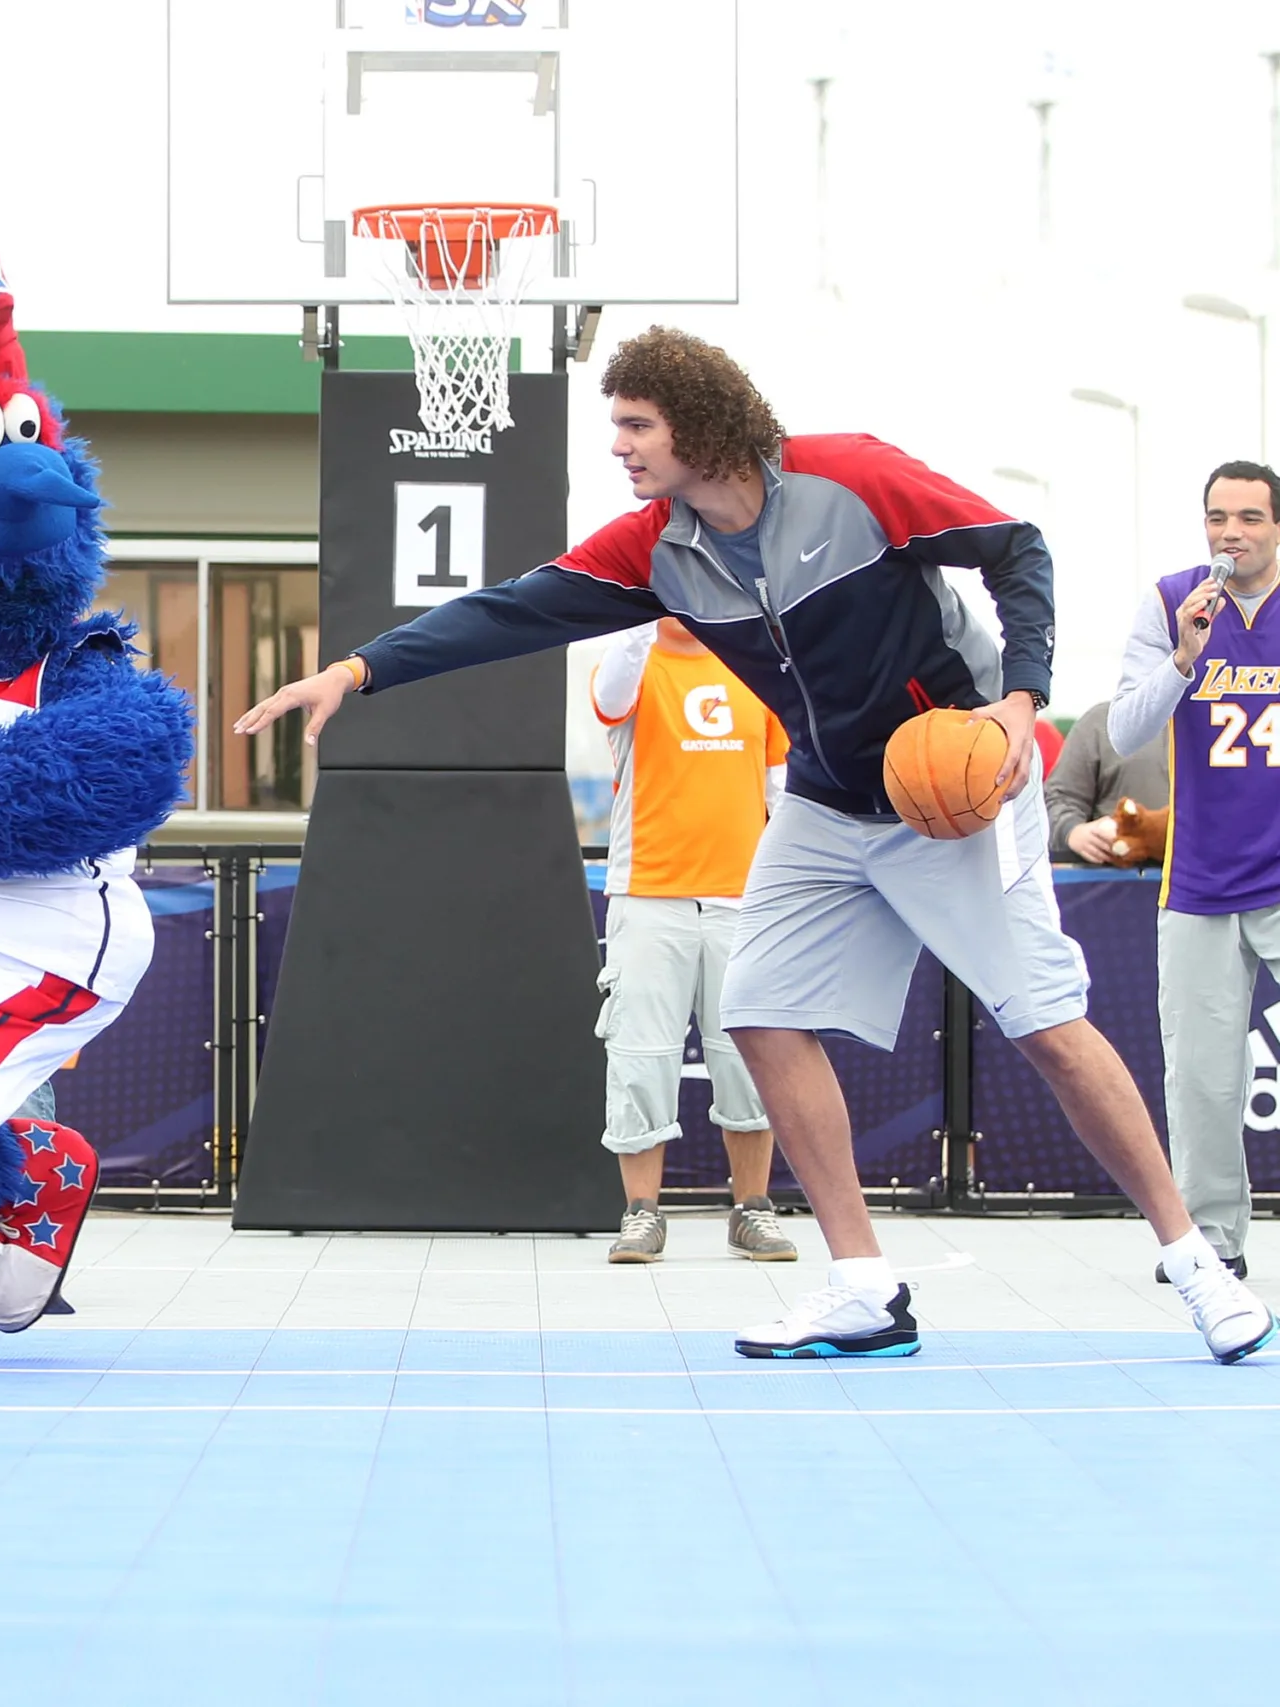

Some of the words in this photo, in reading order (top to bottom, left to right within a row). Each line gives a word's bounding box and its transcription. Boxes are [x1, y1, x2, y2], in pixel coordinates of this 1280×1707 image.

[389, 428, 494, 455] SPALDING
[417, 505, 468, 588] 1
[683, 684, 734, 737] G
[1208, 702, 1280, 768] 24
[680, 739, 745, 752] GATORADE
